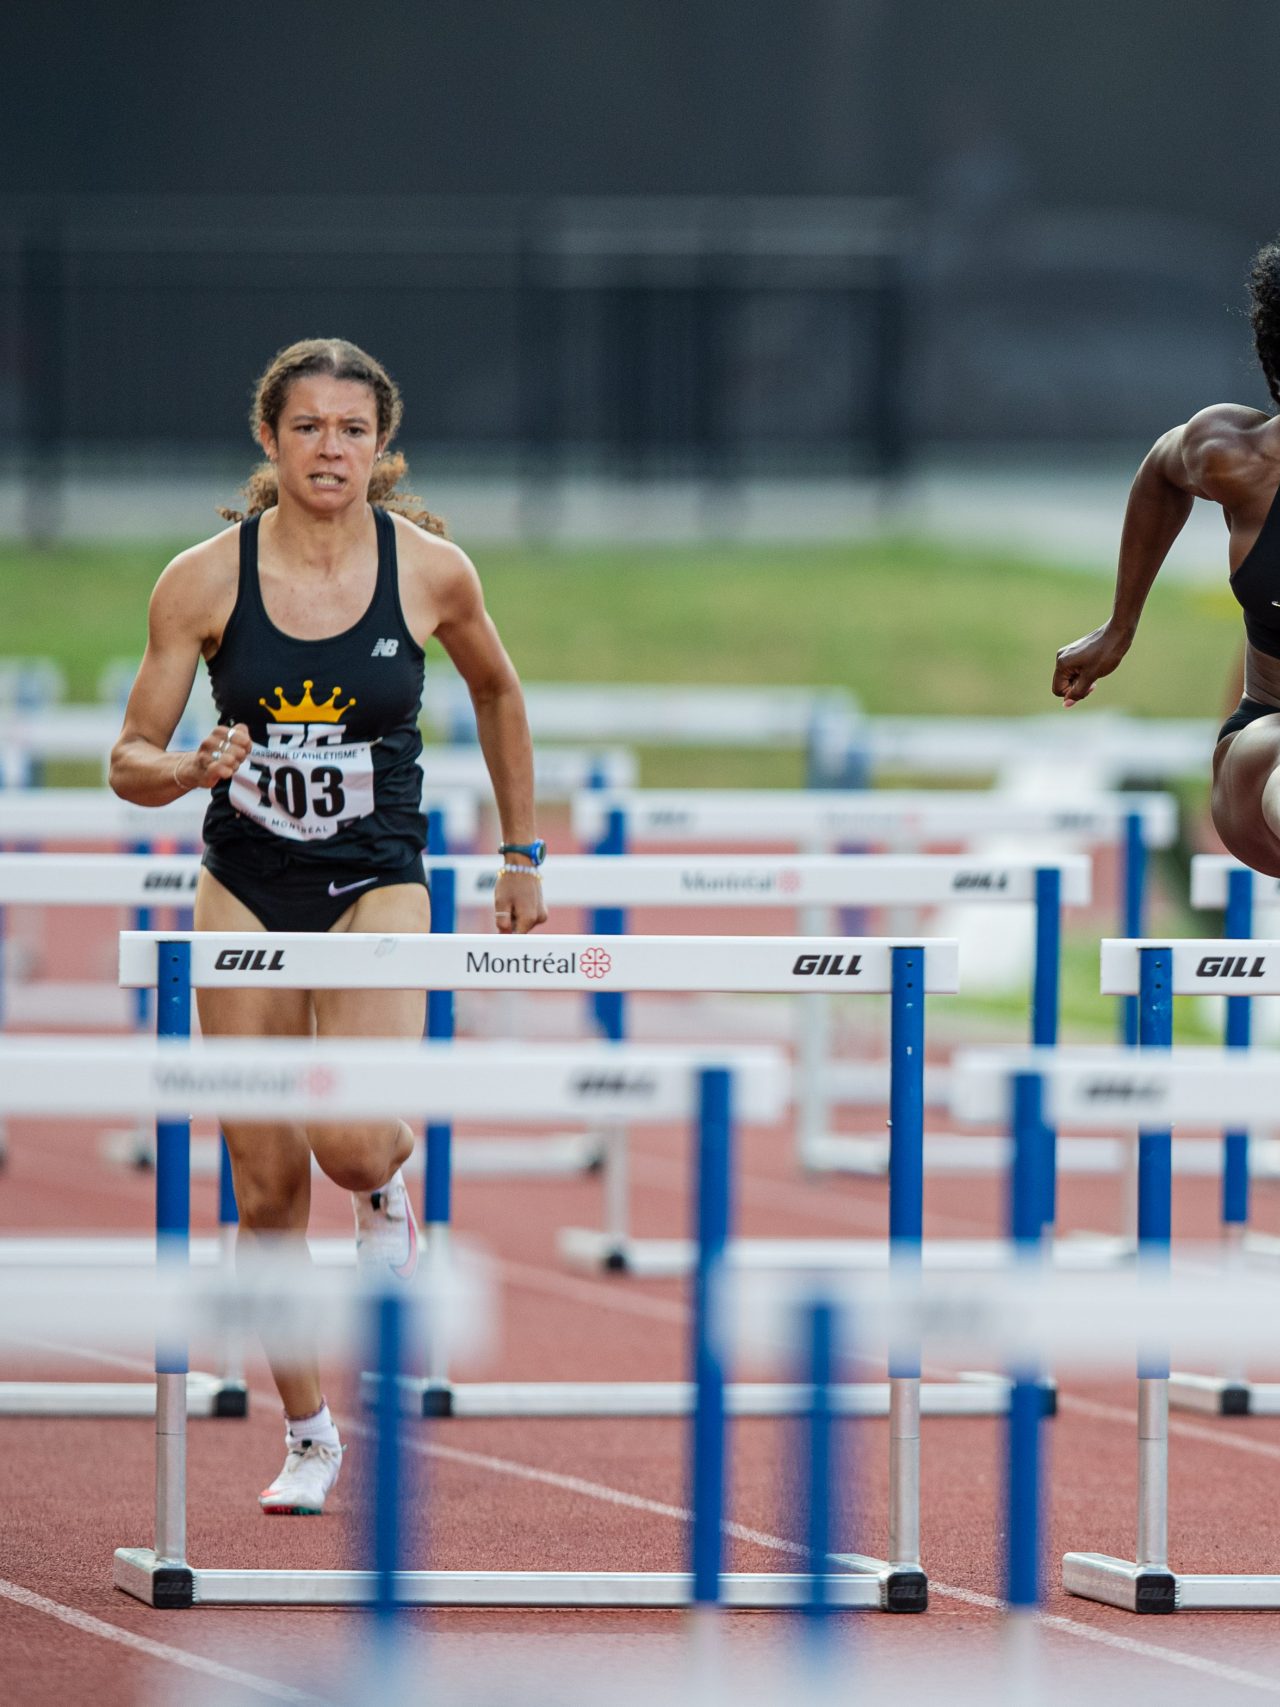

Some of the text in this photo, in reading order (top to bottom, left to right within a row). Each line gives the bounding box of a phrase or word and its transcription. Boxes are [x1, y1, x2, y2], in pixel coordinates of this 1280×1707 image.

[371, 638, 399, 657] NB
[215, 949, 285, 971] GILL
[467, 951, 576, 975] Montréal
[792, 954, 862, 976] GILL
[1196, 956, 1266, 978] GILL
